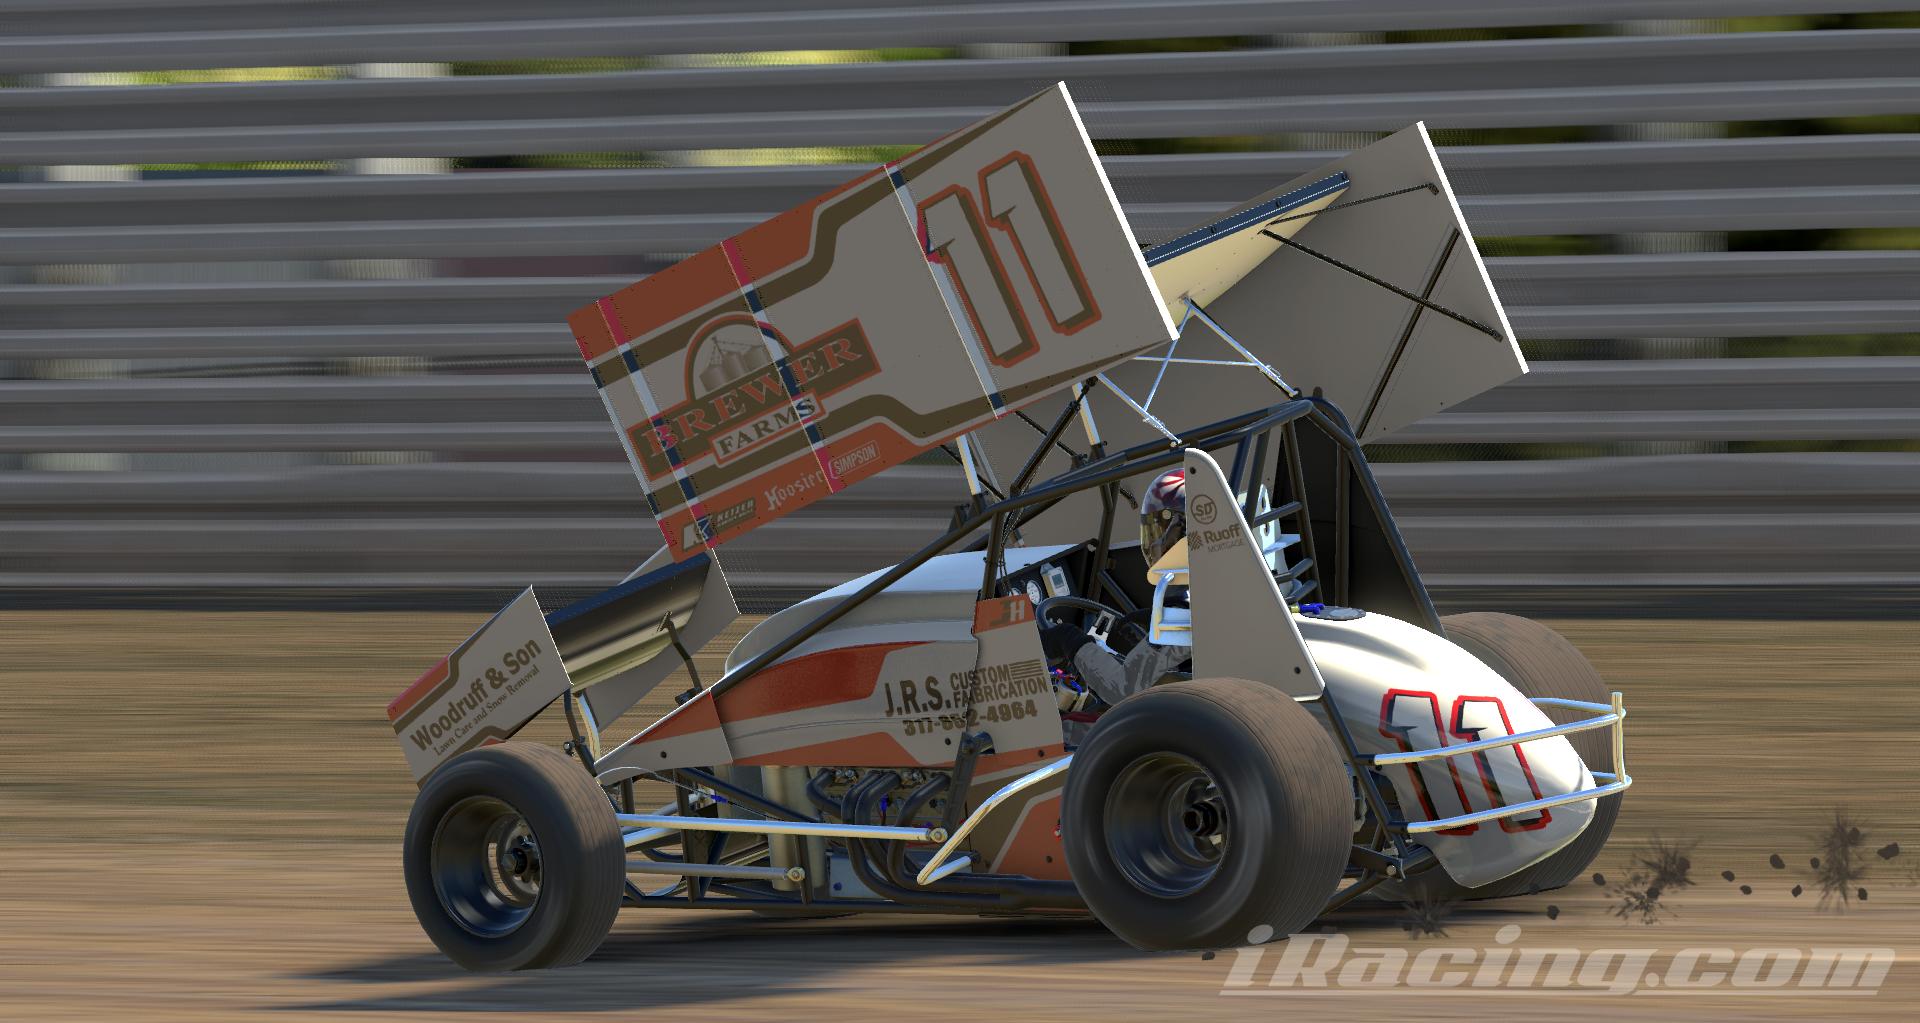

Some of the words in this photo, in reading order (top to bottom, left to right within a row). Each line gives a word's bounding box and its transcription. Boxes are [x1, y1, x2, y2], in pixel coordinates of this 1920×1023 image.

[917, 150, 1102, 368] 11
[641, 337, 863, 456] BREWER
[718, 398, 816, 455] FARMS
[834, 443, 877, 475] SIMPSON
[764, 469, 823, 511] Hoosier
[1204, 523, 1241, 544] Ruoff
[409, 678, 489, 752] Woodruff
[484, 667, 509, 690] &
[503, 639, 541, 675] Son
[884, 676, 951, 717] J.R.S.
[950, 664, 1011, 691] CUSTOM
[953, 676, 1048, 709] FABRICATION
[433, 733, 455, 757] Lawn
[454, 721, 474, 742] Care
[474, 706, 488, 726] and
[487, 693, 508, 714] Snow
[506, 665, 540, 696] Removal
[1378, 688, 1552, 836] 11
